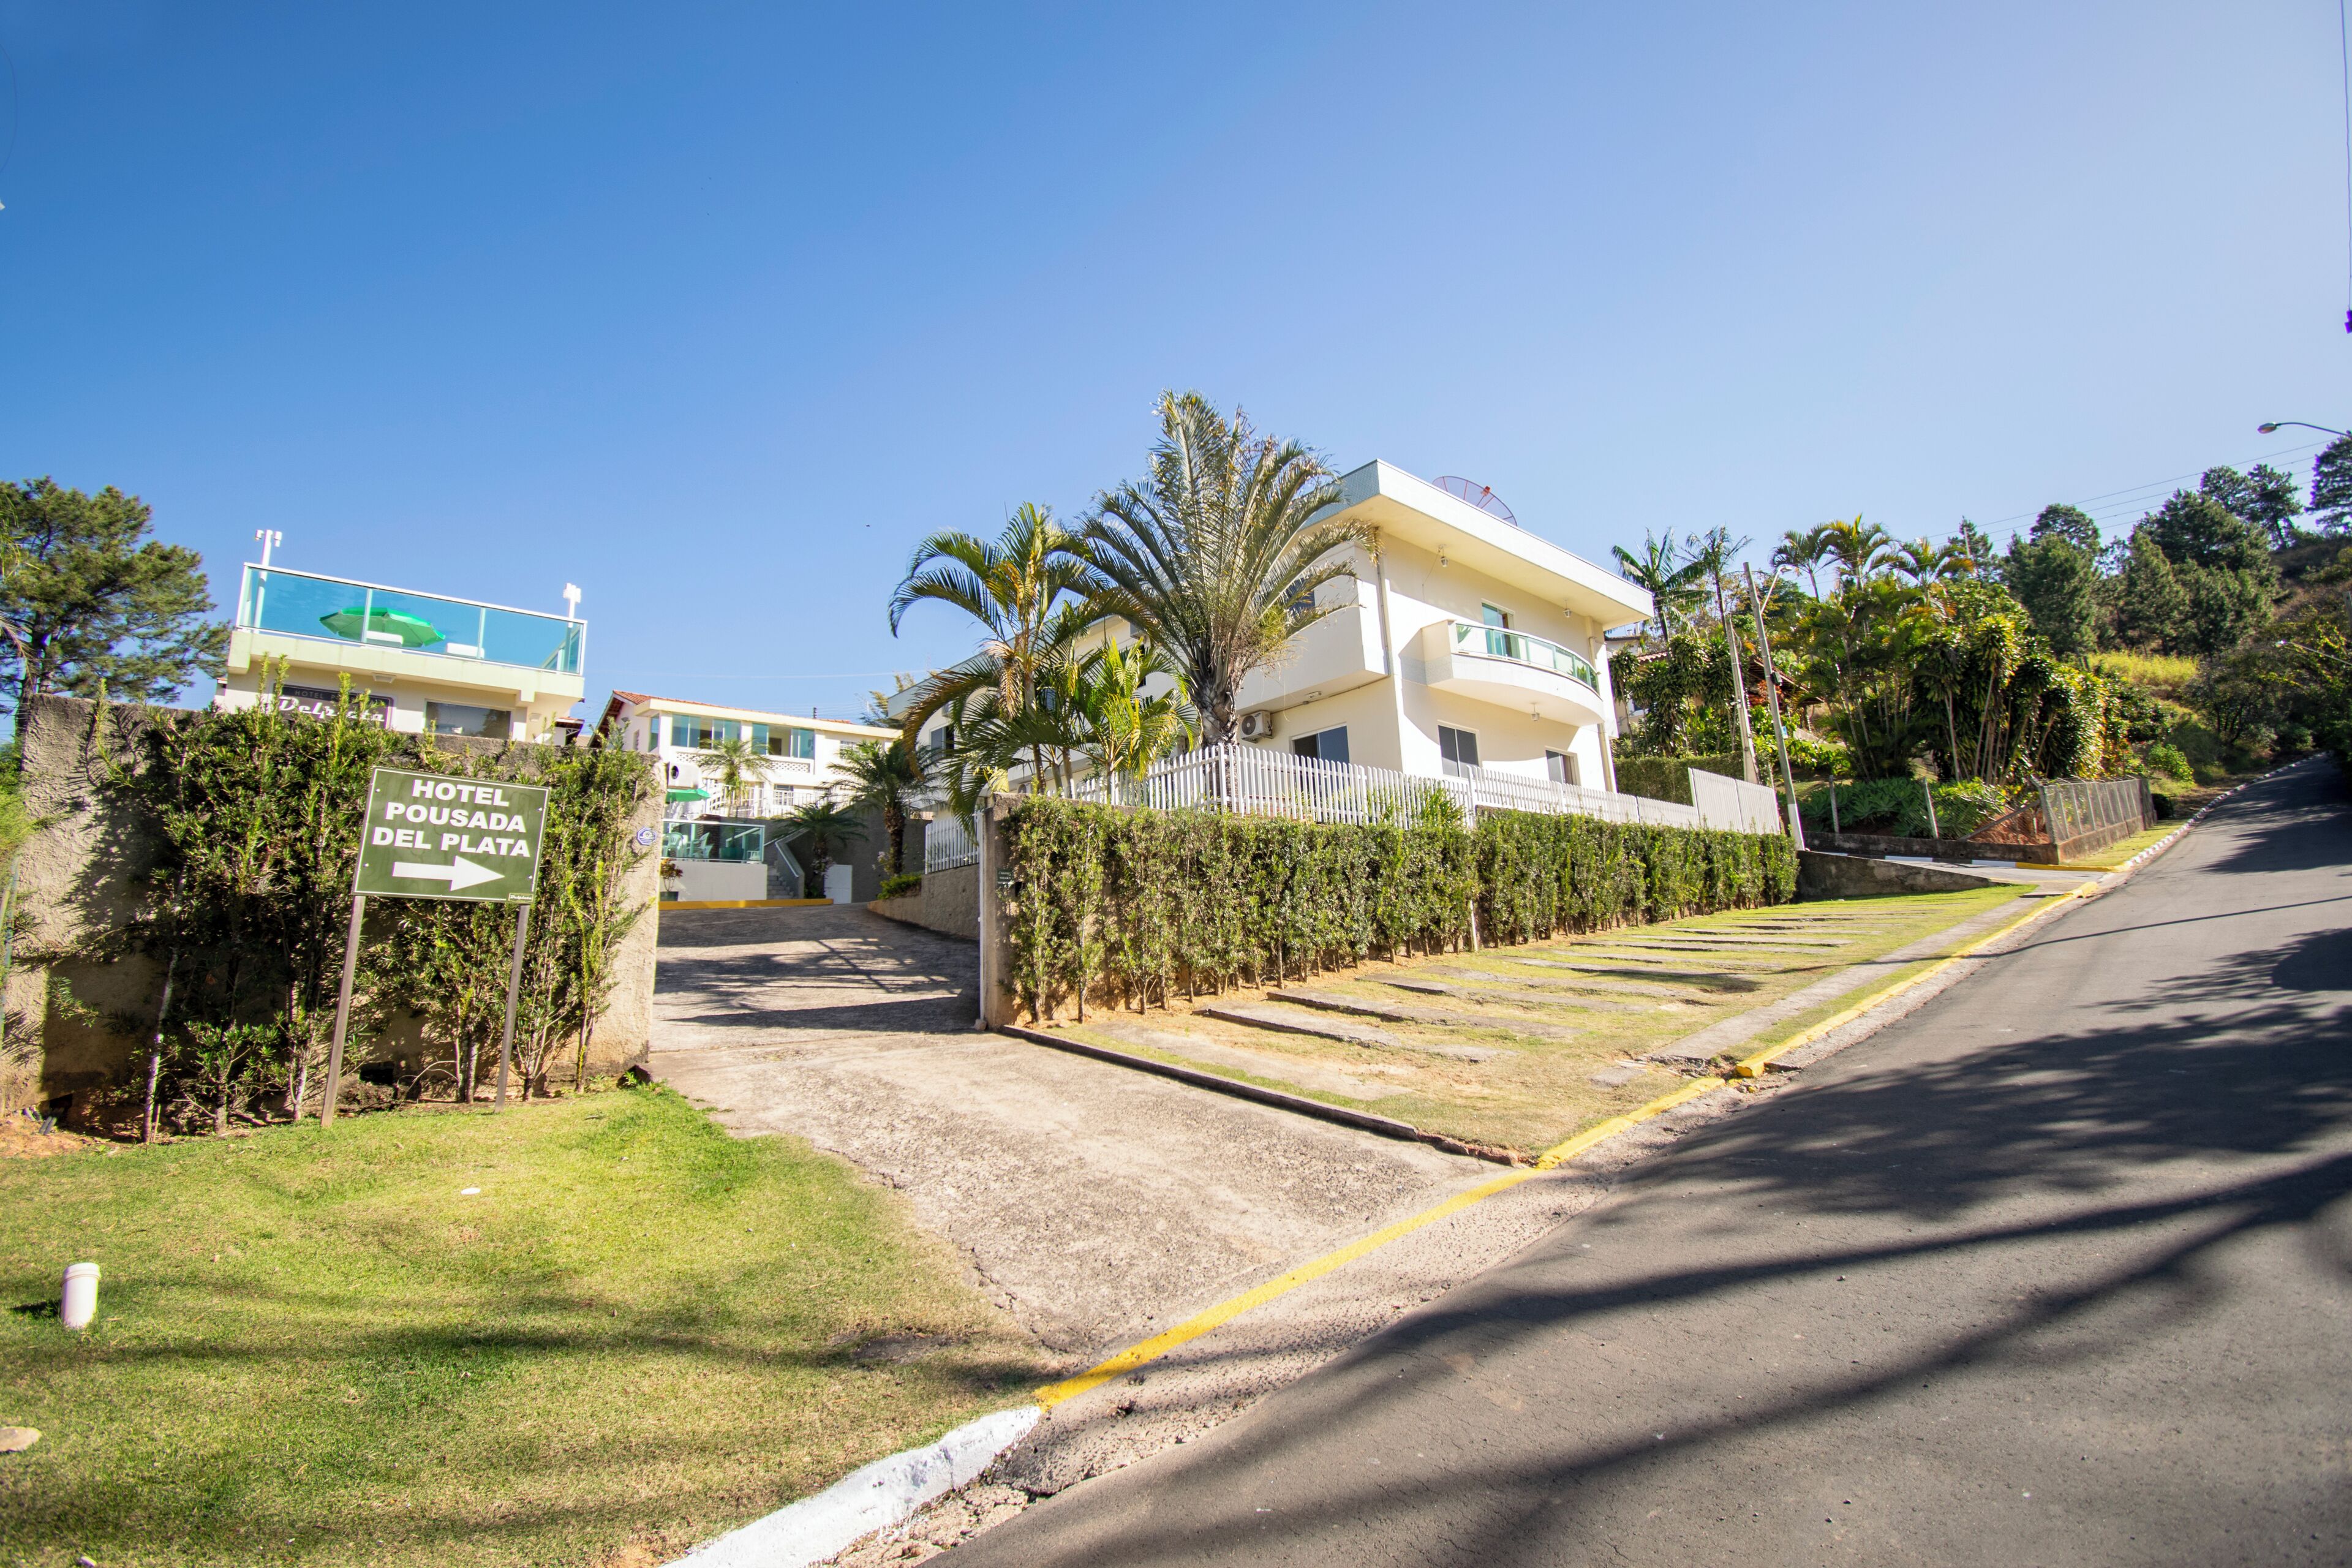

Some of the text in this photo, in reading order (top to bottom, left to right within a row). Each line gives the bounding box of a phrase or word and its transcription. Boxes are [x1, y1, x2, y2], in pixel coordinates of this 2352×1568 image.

[295, 690, 324, 699] HOTEL
[278, 696, 385, 722] Delpata
[412, 779, 510, 807] HOTEL
[385, 802, 527, 833] POUSADA
[371, 827, 530, 858] DEL PLATA
